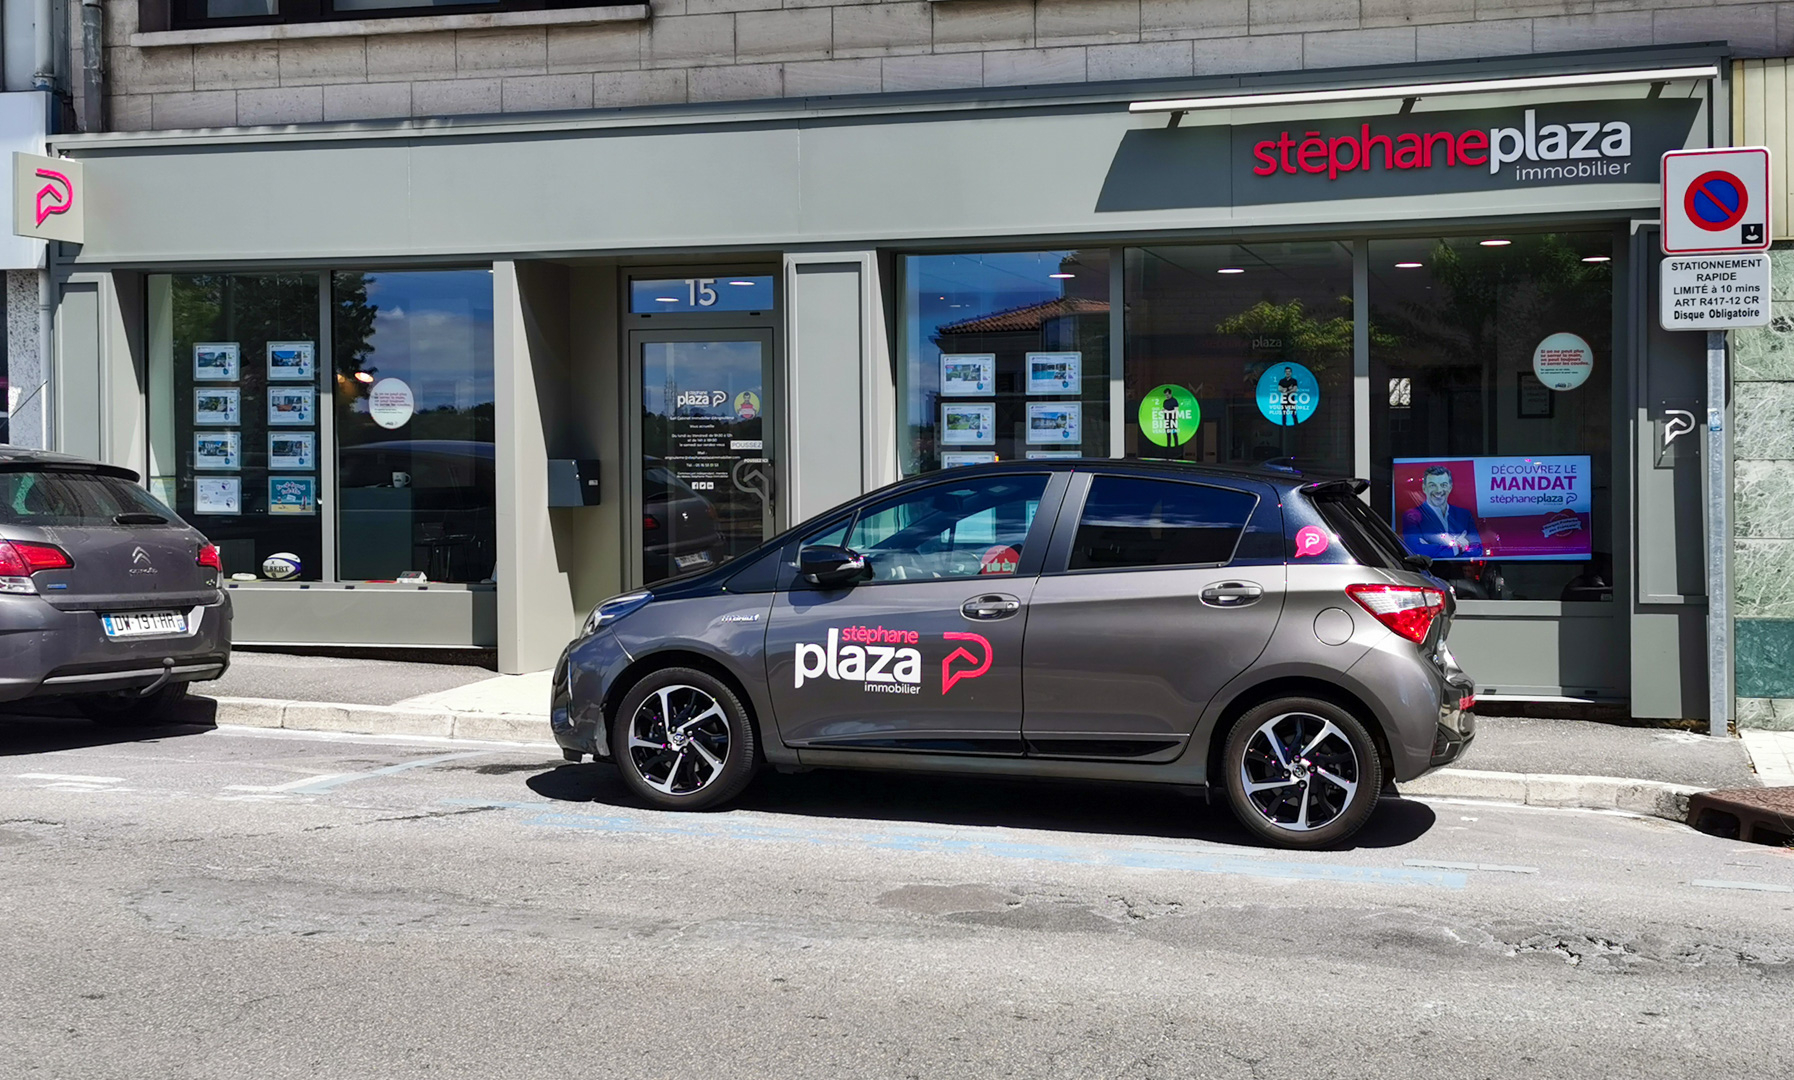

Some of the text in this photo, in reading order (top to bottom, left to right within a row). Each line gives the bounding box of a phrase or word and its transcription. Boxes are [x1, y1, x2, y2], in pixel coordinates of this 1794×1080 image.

[1516, 159, 1631, 181] immobilier
[1671, 259, 1762, 271] STATIONNEMENT
[1696, 272, 1737, 282] RAPIDE
[685, 279, 716, 306] 15
[1673, 284, 1760, 295] LIMITÉ à 10 mins
[1674, 296, 1759, 307] ART R417-12 CR
[1674, 308, 1760, 321] Disque Obligatoire
[1252, 336, 1283, 349] plaza
[677, 391, 709, 408] plaza
[1152, 410, 1192, 420] ESTIME
[1152, 420, 1178, 429] BIEN
[1491, 464, 1577, 474] DÉCOUVREZ LE
[1490, 476, 1577, 491] MANDAT
[795, 628, 921, 688] plaza
[864, 681, 921, 694] immobilier
